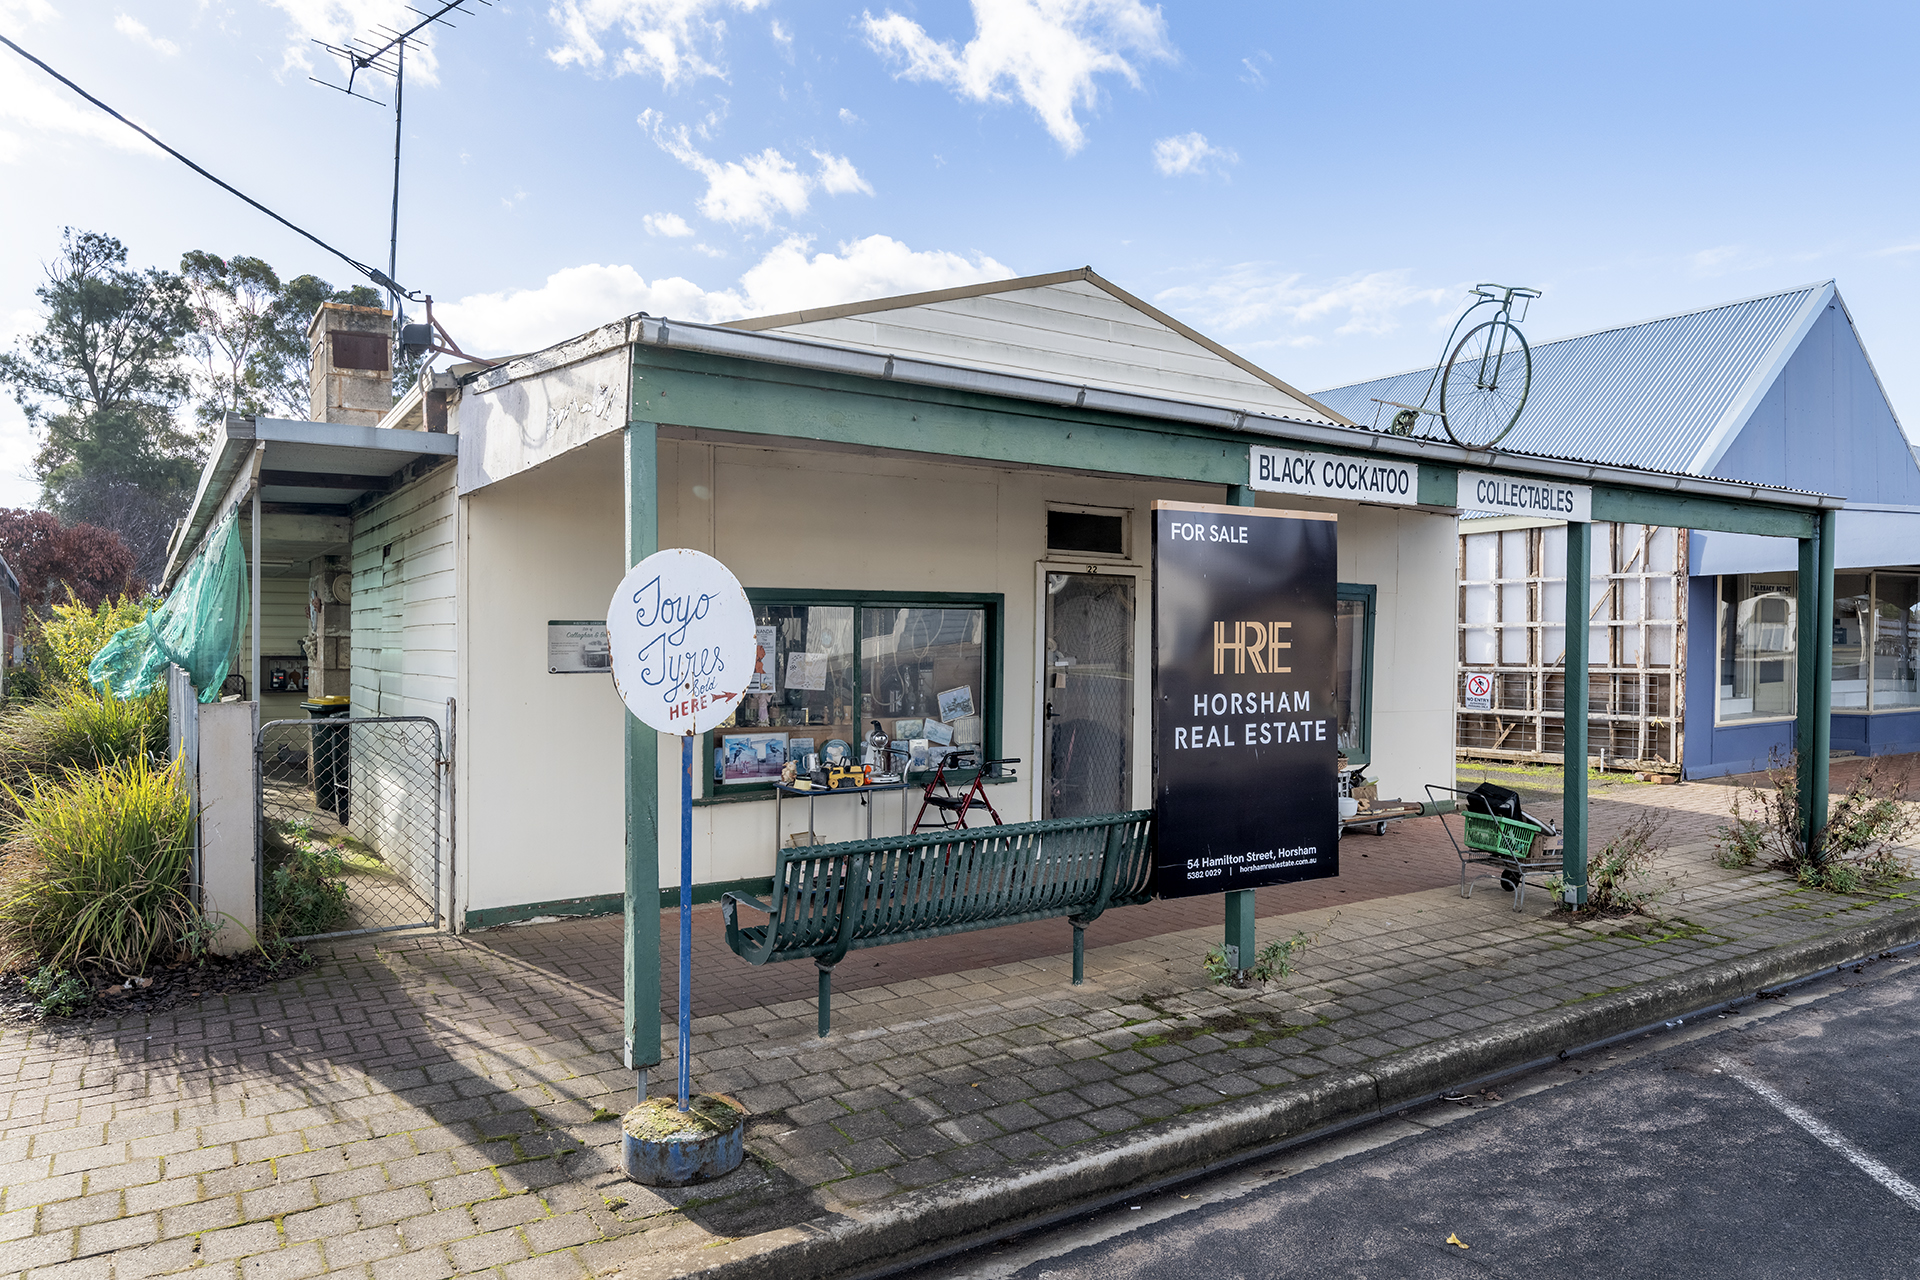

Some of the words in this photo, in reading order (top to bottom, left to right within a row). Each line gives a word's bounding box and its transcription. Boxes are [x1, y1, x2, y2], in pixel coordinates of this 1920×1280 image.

[1259, 454, 1316, 486] BLACK
[1322, 461, 1409, 495] COCKATOO
[1476, 479, 1574, 514] COLLECTABLES
[1171, 522, 1206, 542] FOR
[1209, 525, 1249, 544] SALE
[1087, 565, 1098, 574] 22
[1750, 584, 1775, 592] PHARMACY
[633, 575, 721, 646] Toyo
[1213, 621, 1292, 675] HRE
[638, 633, 725, 703] Tyres
[687, 677, 718, 698] Sold
[669, 695, 708, 721] HERE
[1193, 690, 1310, 717] HORSHAM
[1174, 724, 1236, 750] REAL
[1245, 719, 1327, 746] ESTATE
[1187, 858, 1200, 870] 54
[1201, 854, 1245, 868] Hamilton
[1246, 849, 1277, 863] Street,
[1278, 845, 1317, 859] Horsham
[1187, 871, 1204, 880] 5382
[1205, 868, 1222, 878] 0029
[1239, 857, 1317, 873] horshamrealestate.com.au
